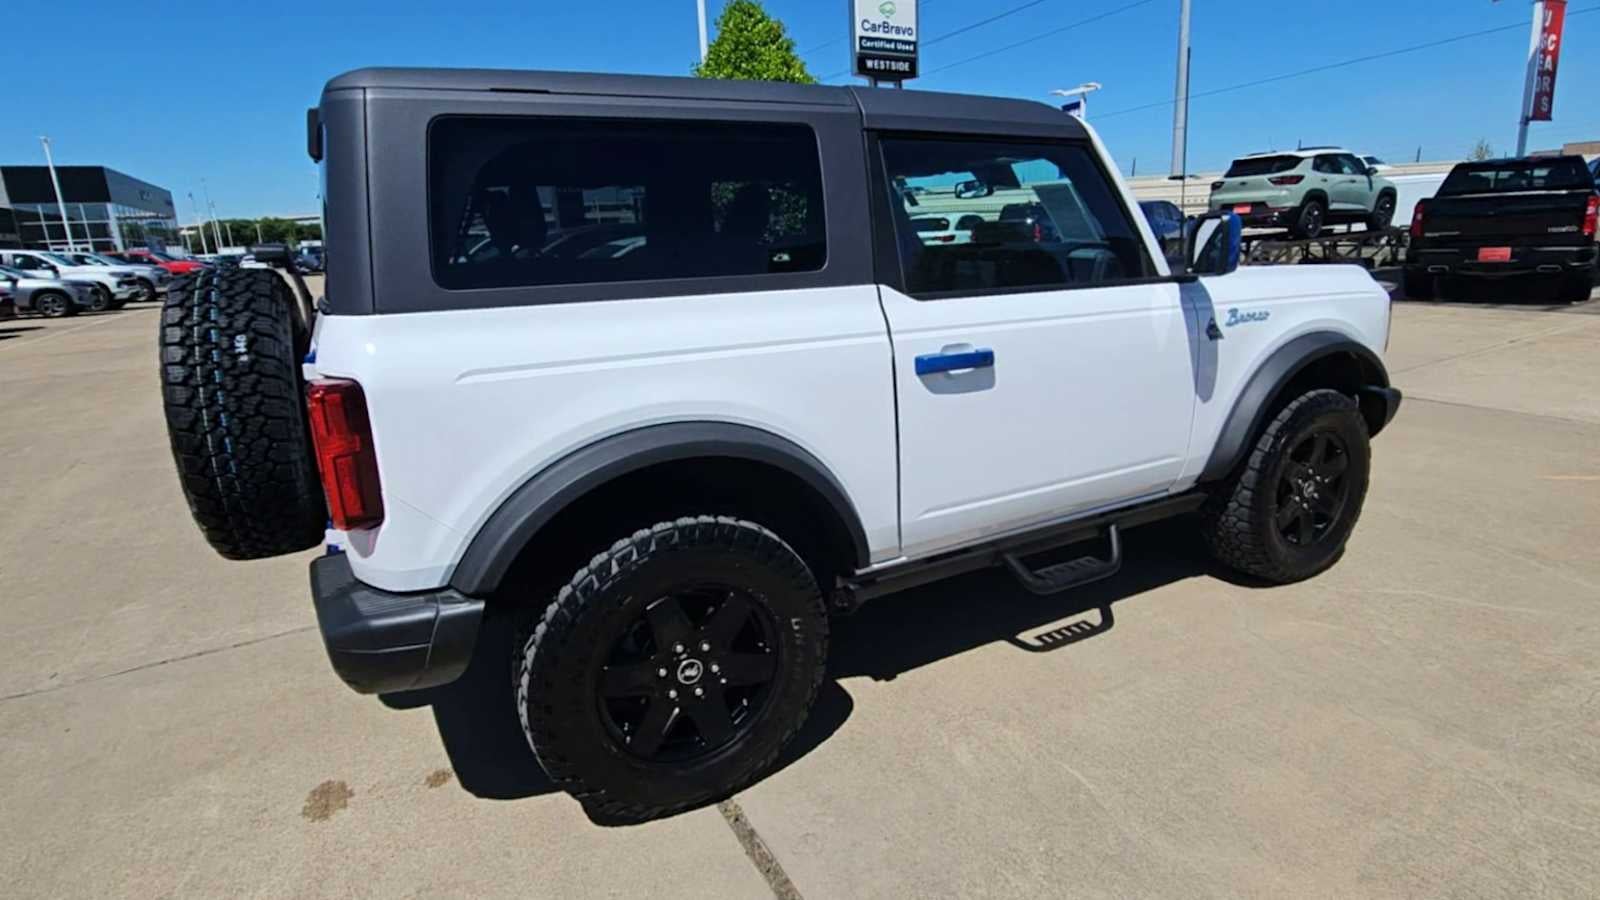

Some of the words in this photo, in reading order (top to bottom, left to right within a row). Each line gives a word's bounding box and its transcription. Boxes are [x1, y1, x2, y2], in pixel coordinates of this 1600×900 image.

[861, 19, 914, 36] CarBravo
[861, 39, 895, 49] Certified
[896, 42, 915, 51] Used
[865, 59, 911, 72] WESTSIDE
[1540, 33, 1558, 112] CARS
[1225, 307, 1271, 327] Bronco
